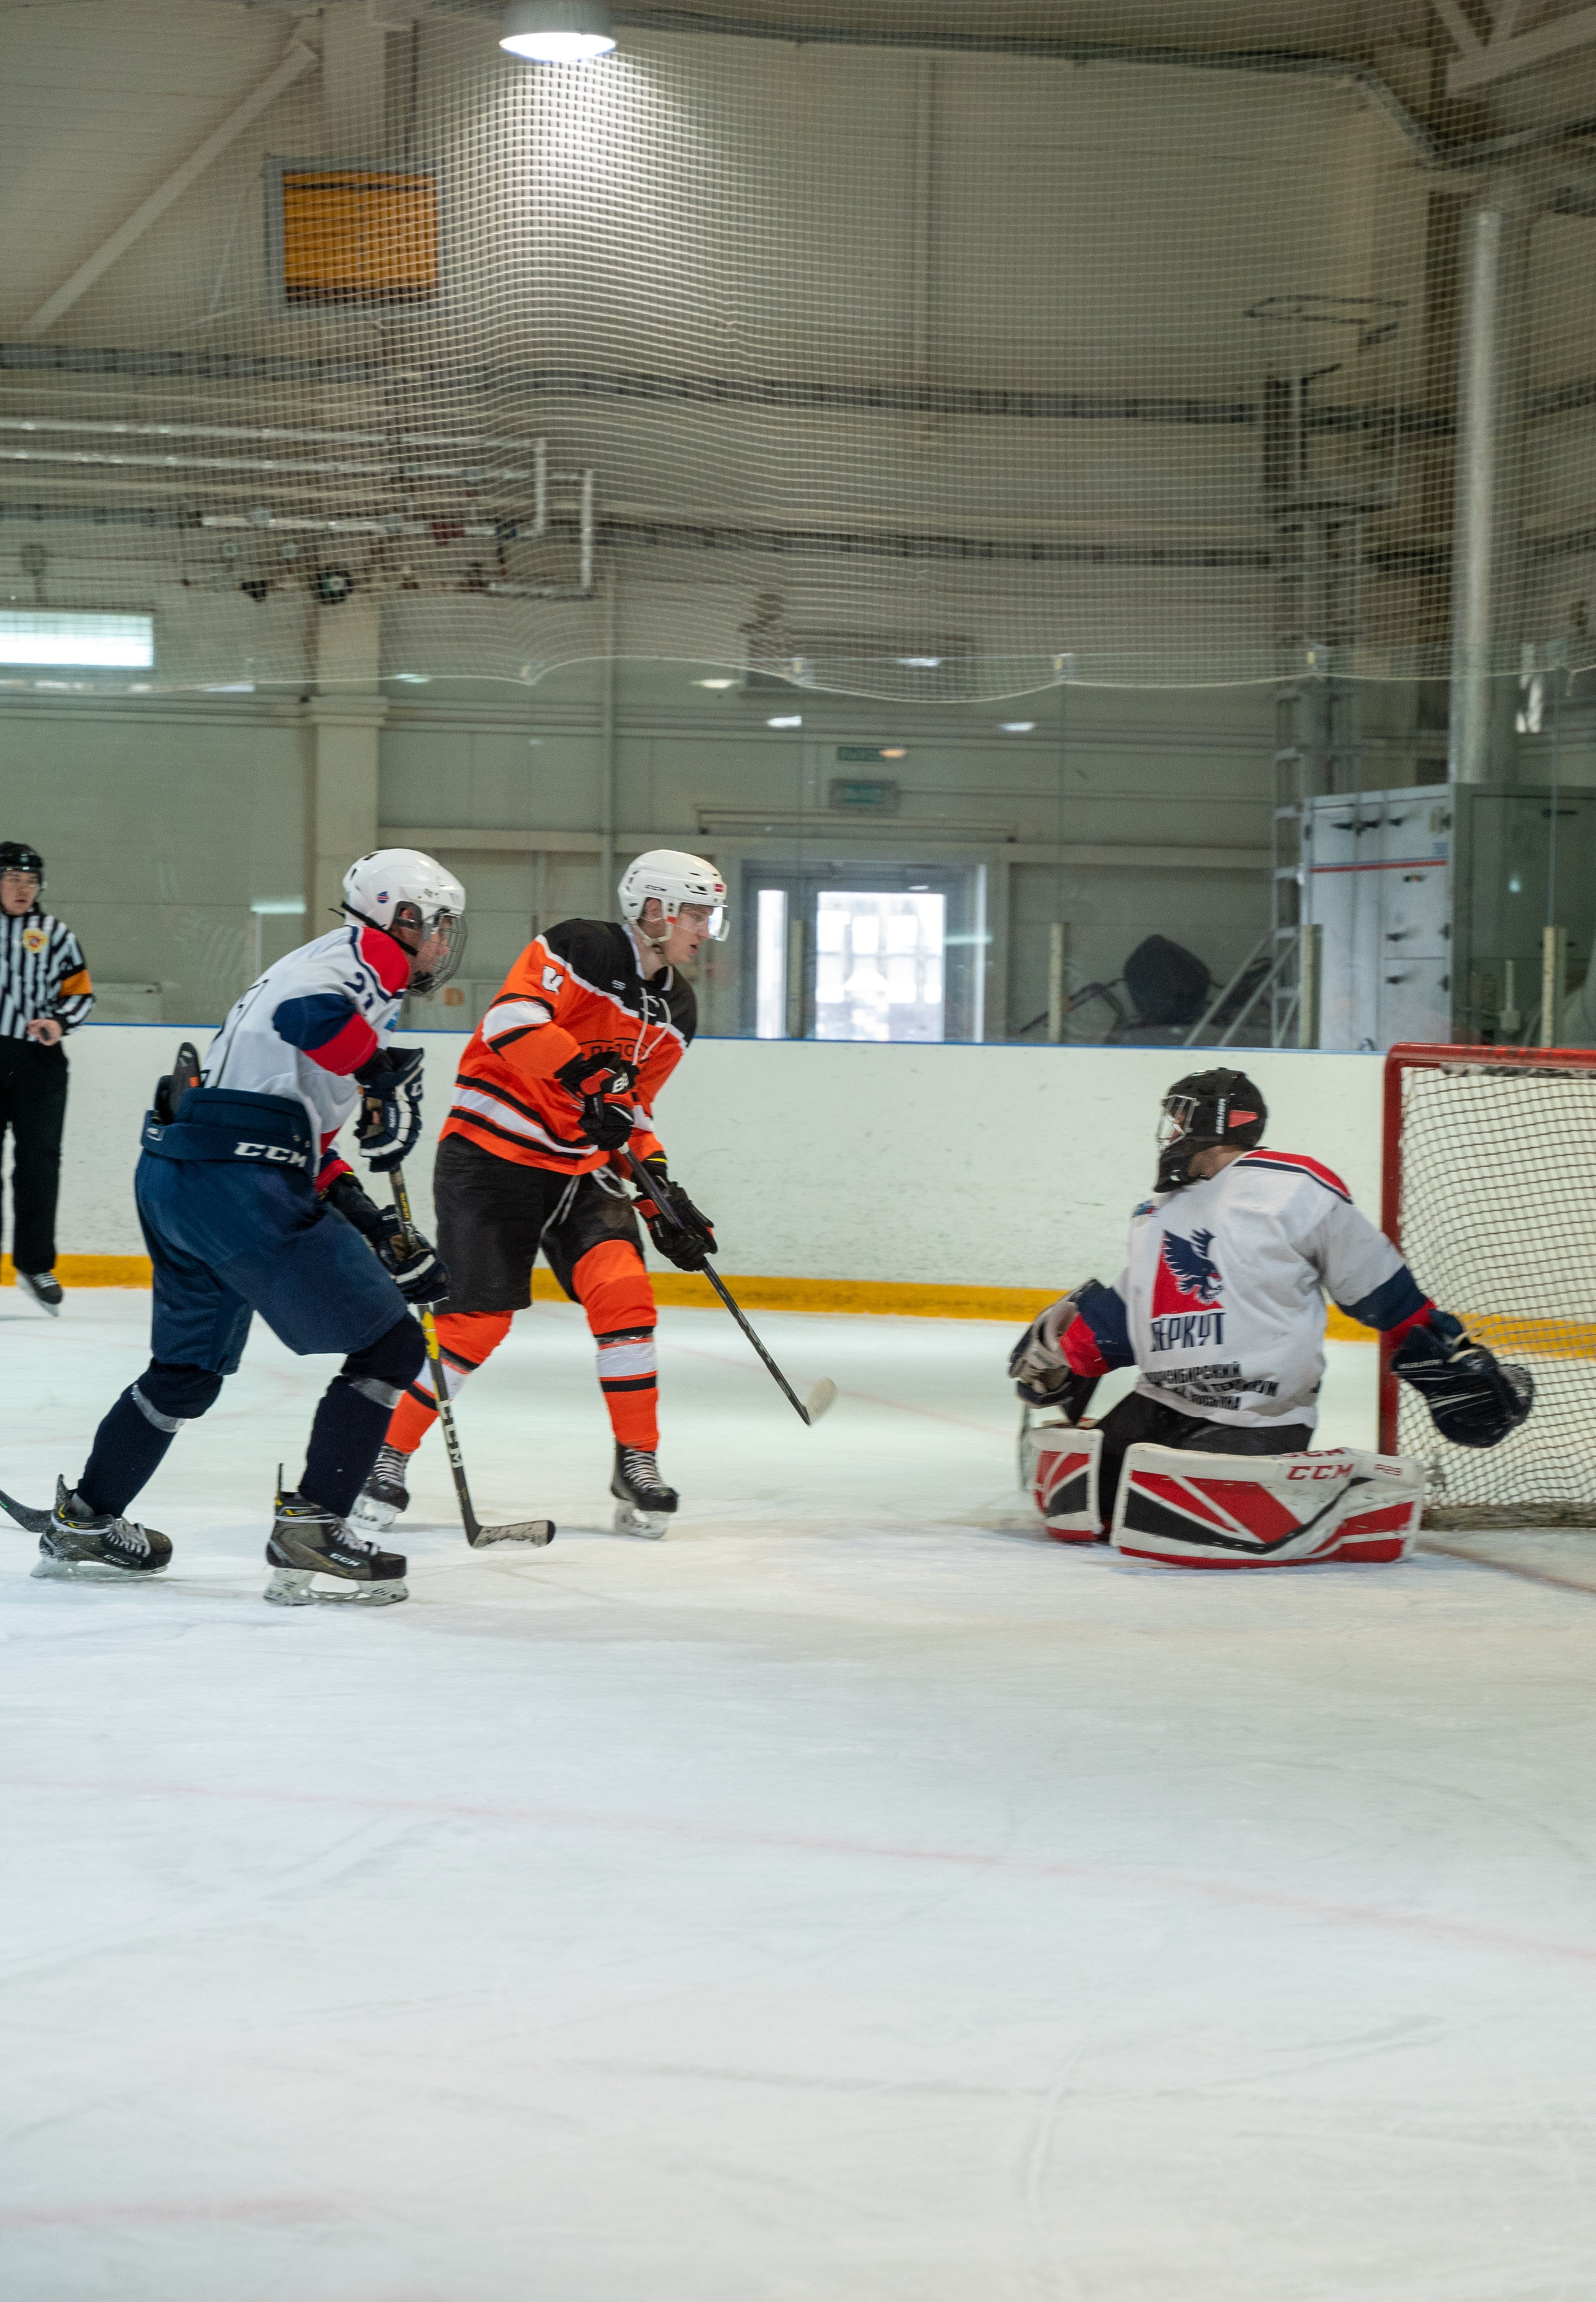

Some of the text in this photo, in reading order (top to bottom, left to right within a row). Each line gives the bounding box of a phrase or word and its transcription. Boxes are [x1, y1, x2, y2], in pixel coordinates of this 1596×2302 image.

[1216, 1099, 1226, 1134] BAUER
[233, 1142, 307, 1167] CCM
[1286, 1463, 1355, 1480] CCM
[329, 1553, 361, 1567] CCM
